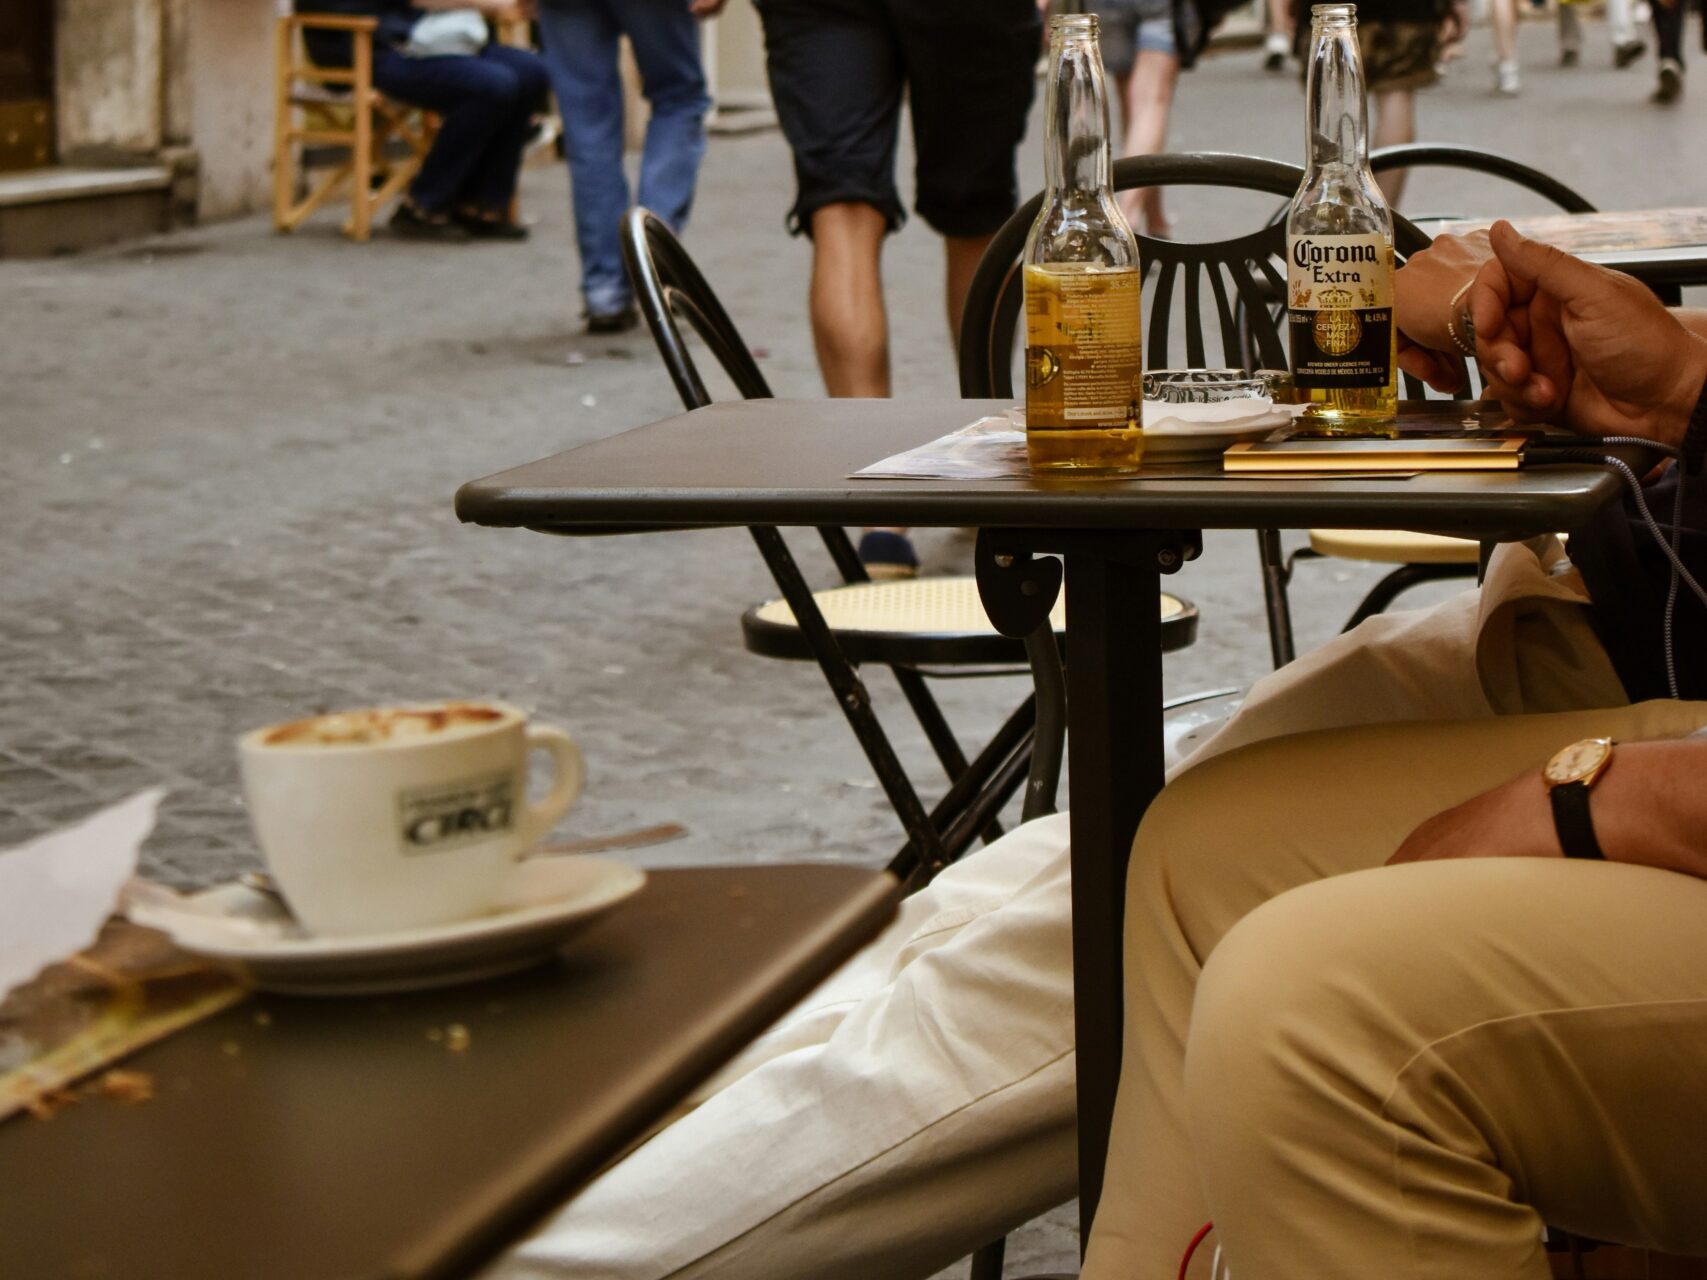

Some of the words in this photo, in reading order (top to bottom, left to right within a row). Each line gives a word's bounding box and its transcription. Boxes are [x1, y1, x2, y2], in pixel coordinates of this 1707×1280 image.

[1293, 239, 1377, 271] Corona
[1312, 266, 1361, 283] Extra
[1329, 315, 1342, 323] LA
[1316, 323, 1356, 331] CERVEZA
[1326, 339, 1346, 347] FINA
